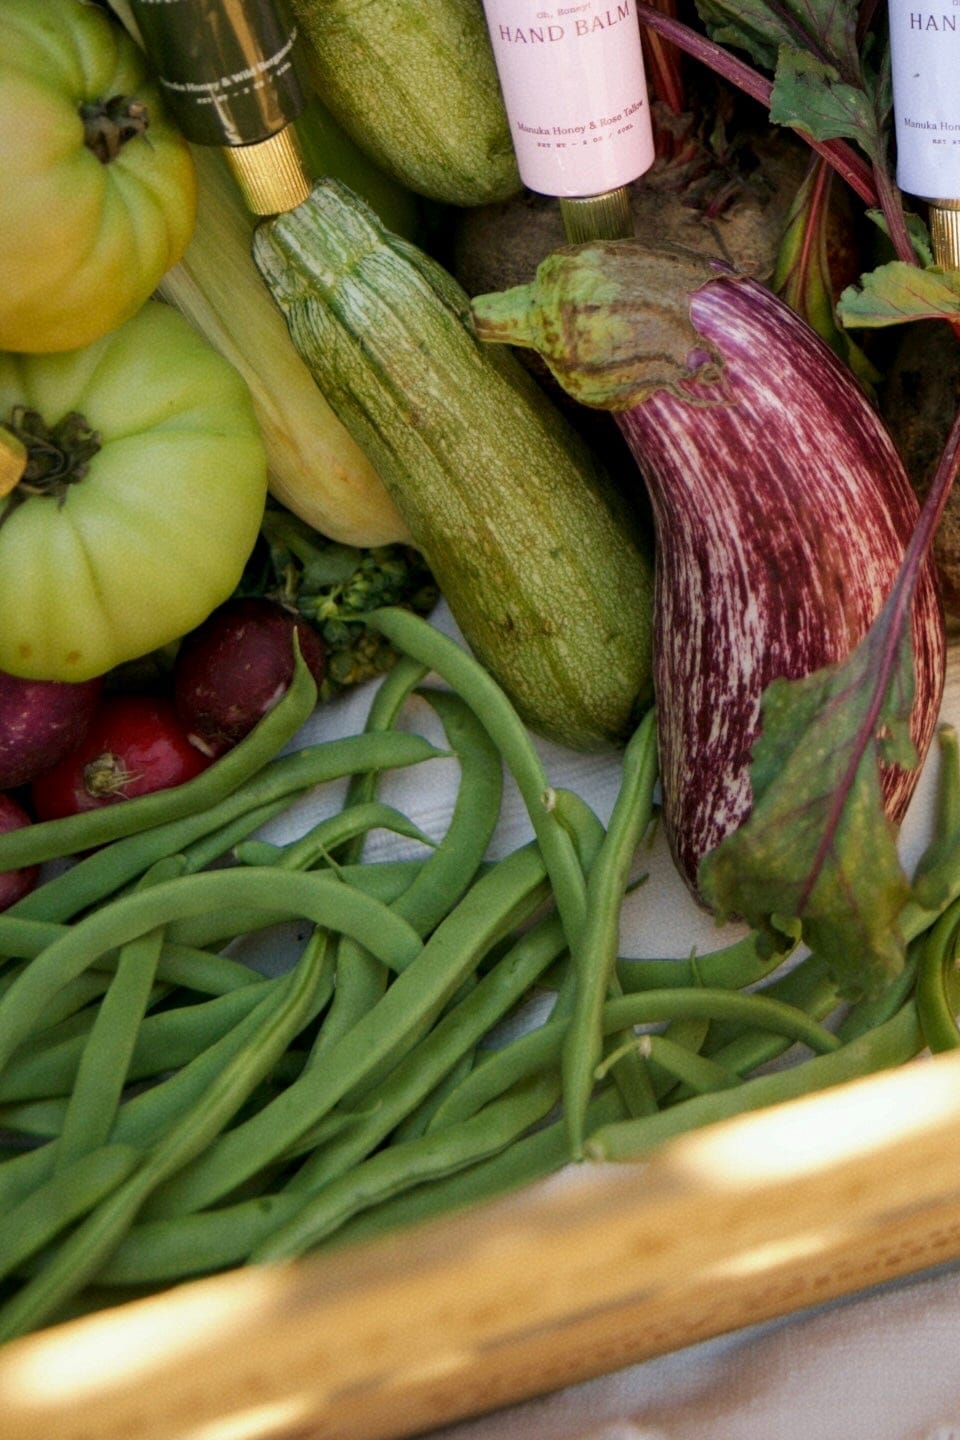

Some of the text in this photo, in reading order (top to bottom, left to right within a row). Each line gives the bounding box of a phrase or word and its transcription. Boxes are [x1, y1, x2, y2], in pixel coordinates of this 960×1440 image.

[499, 0, 631, 44] HAND BALM
[516, 121, 550, 135] Manuka
[553, 124, 586, 136] Honey
[589, 121, 597, 130] &
[600, 114, 622, 127] Rose
[904, 117, 937, 130] Manuka
